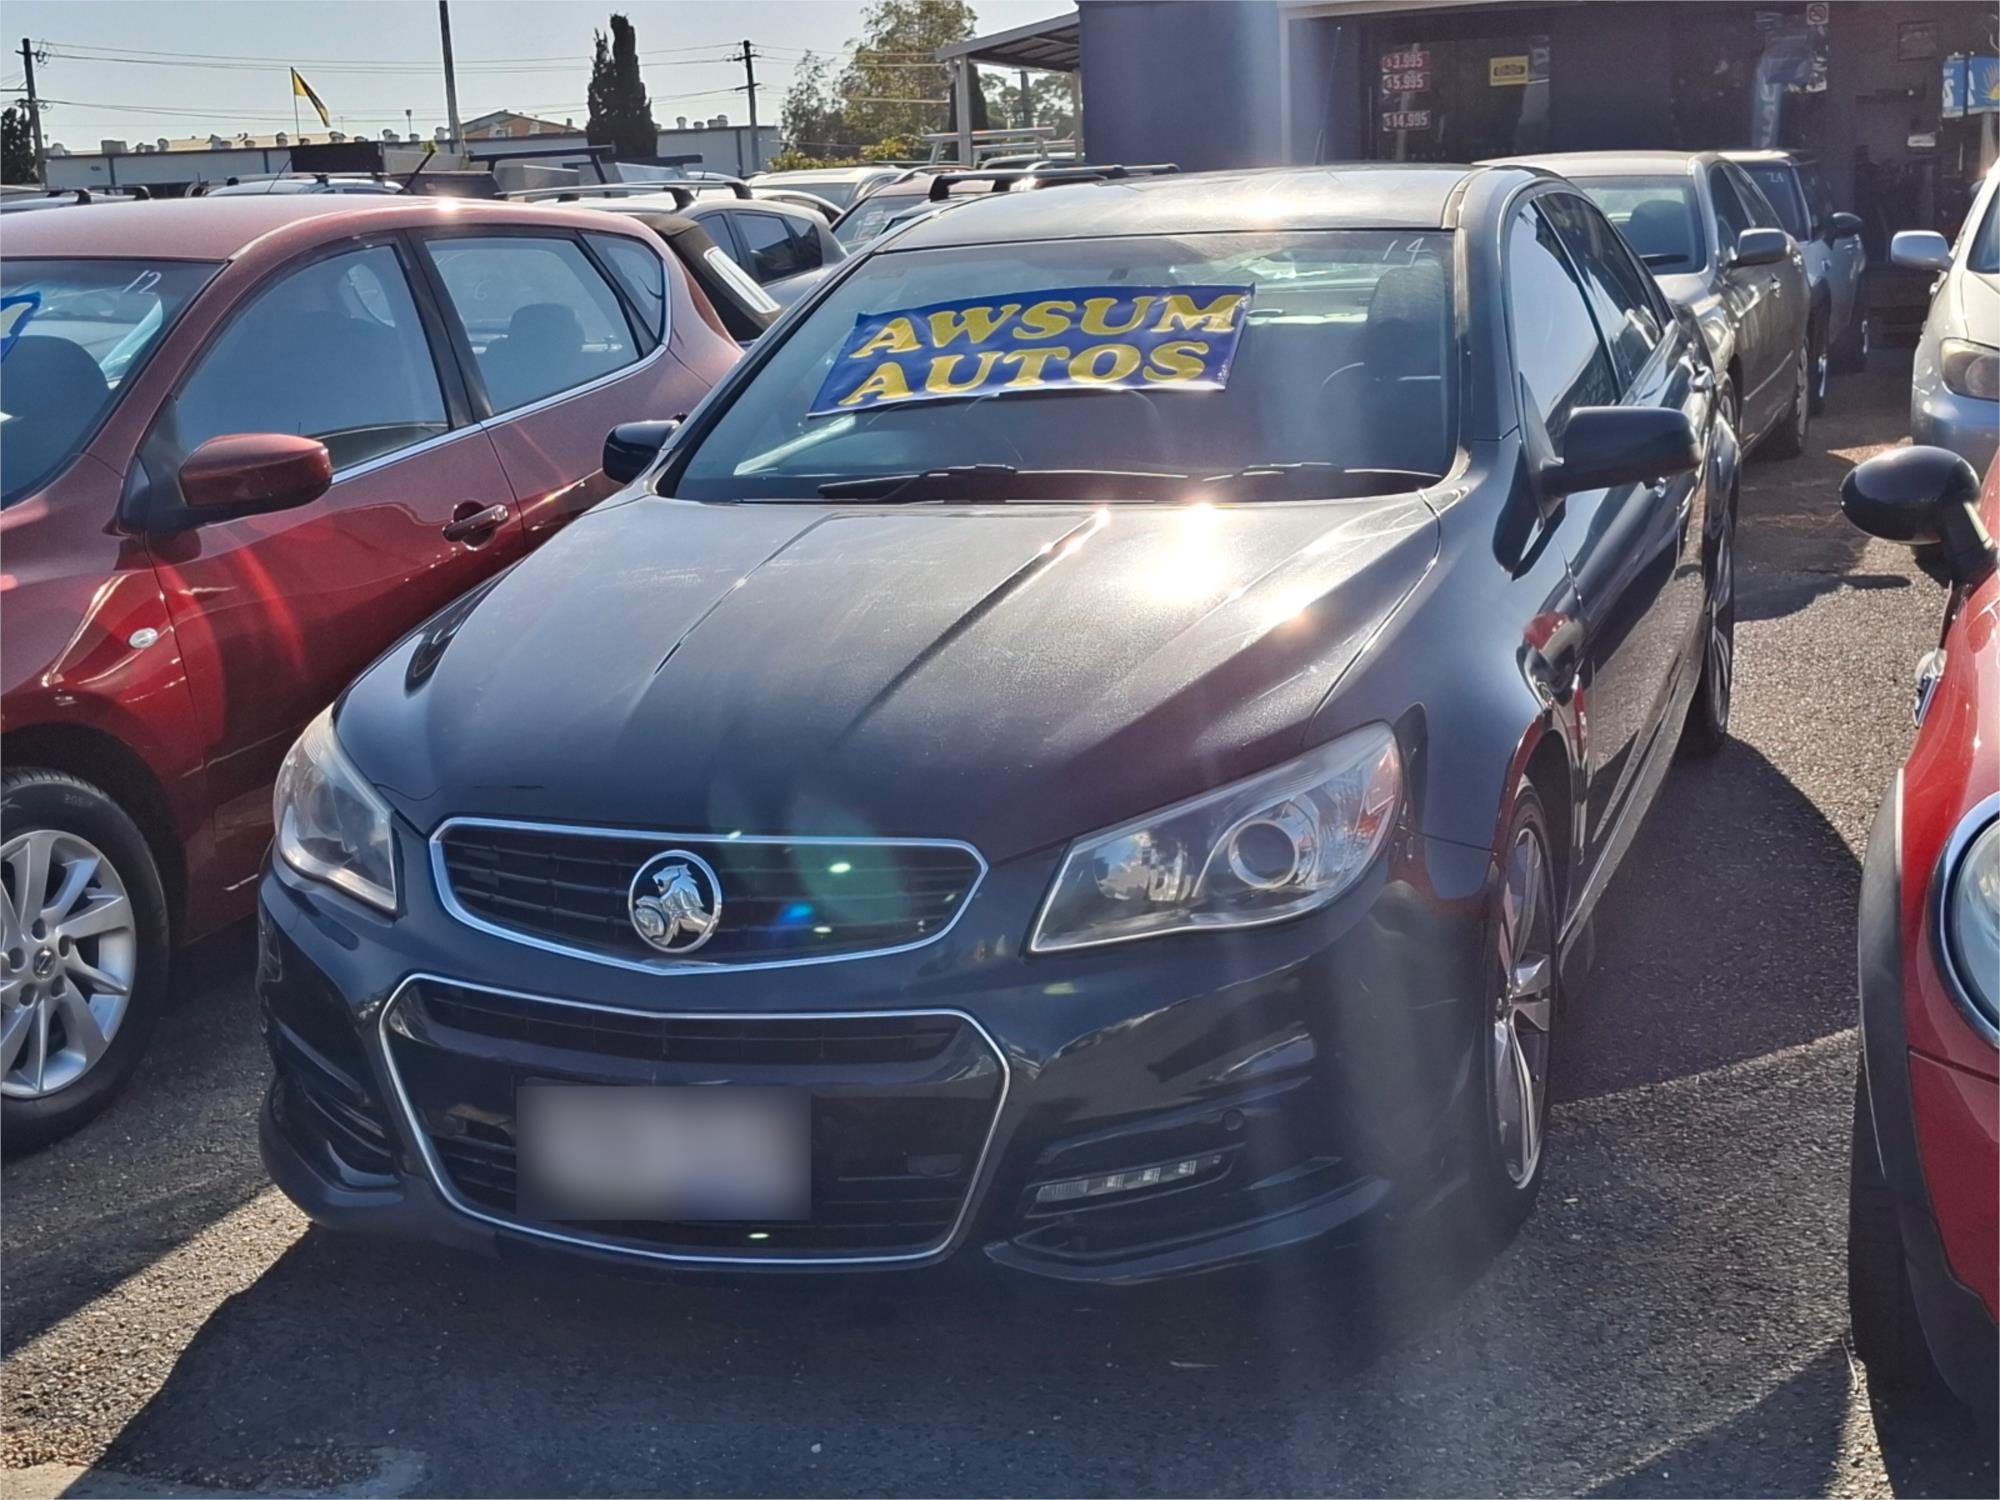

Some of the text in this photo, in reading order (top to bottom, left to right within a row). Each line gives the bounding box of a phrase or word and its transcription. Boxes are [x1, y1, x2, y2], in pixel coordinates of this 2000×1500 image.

[1382, 236, 1432, 268] 14
[121, 270, 162, 295] 12
[848, 293, 1246, 359] AWSUM
[838, 340, 1210, 406] AUTOS
